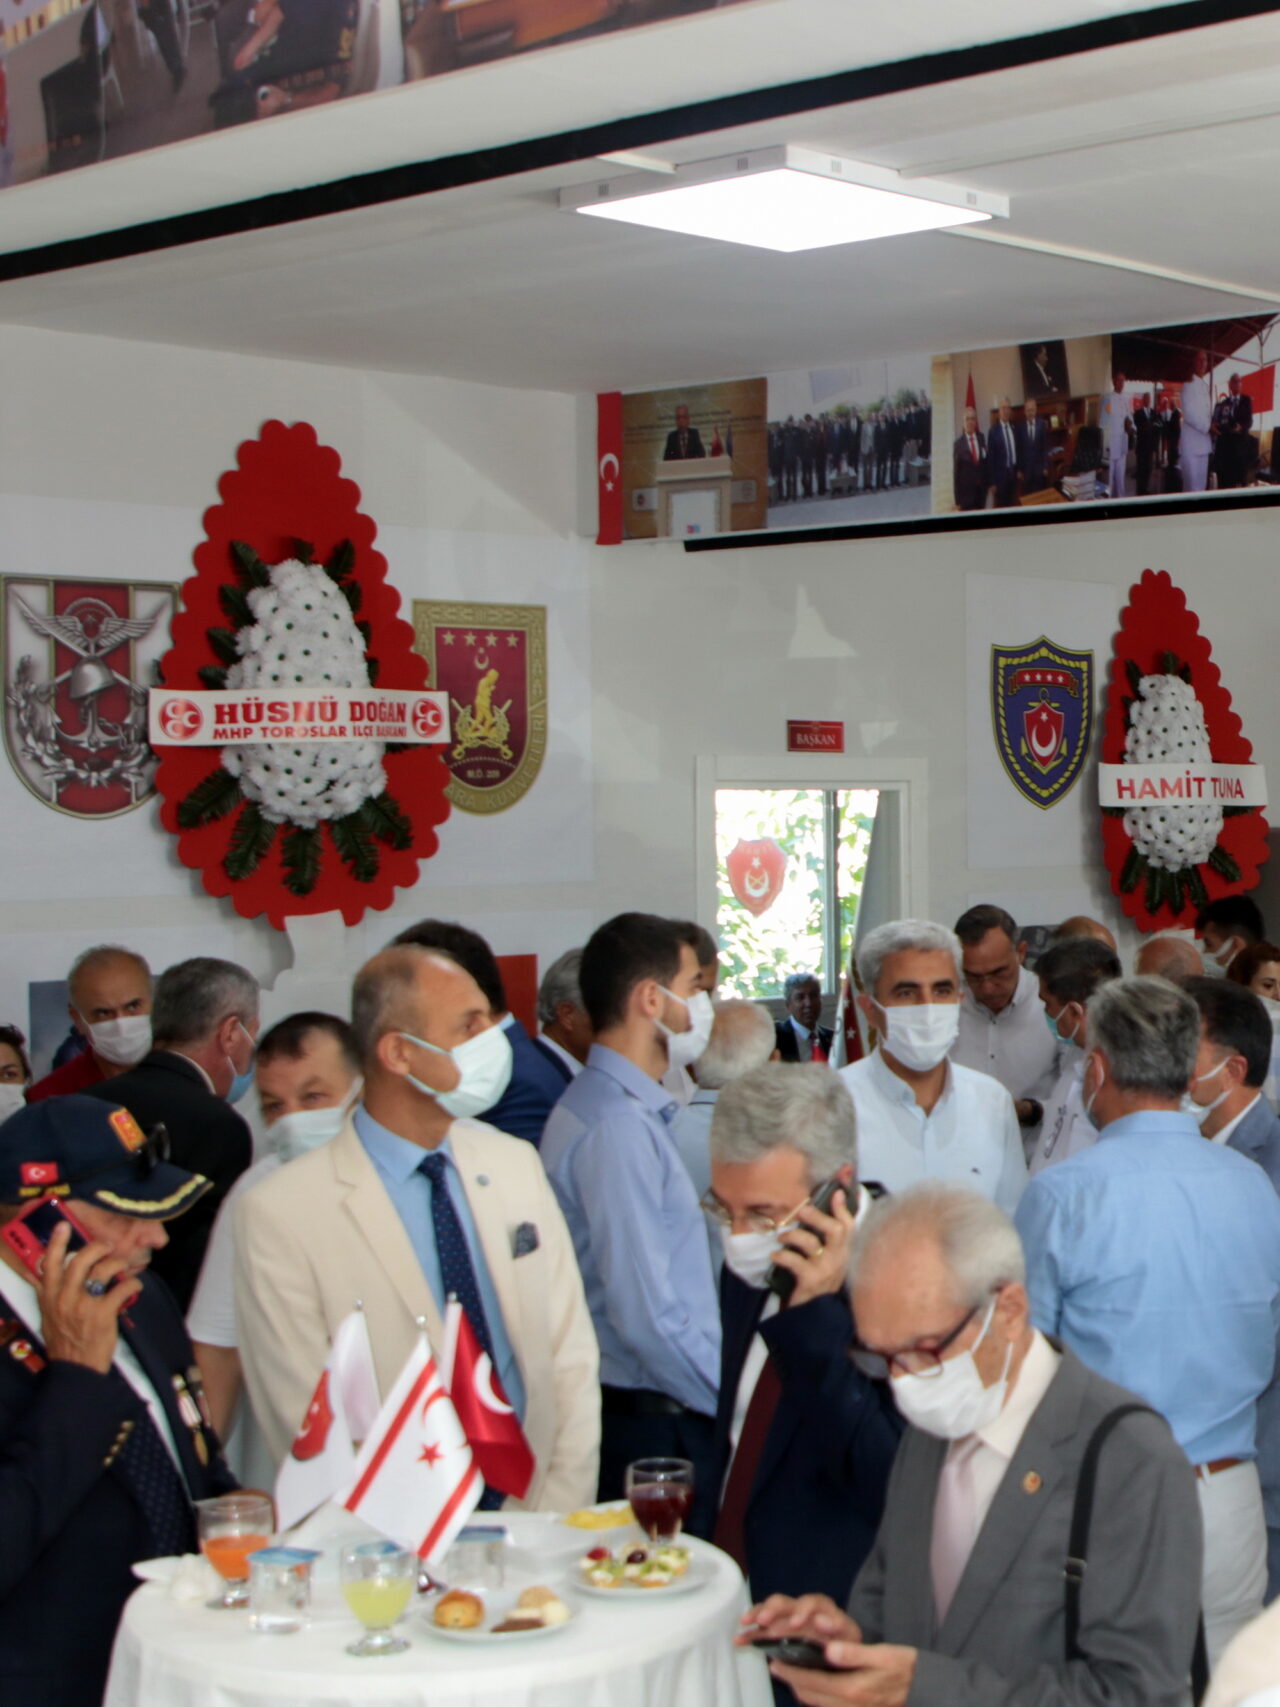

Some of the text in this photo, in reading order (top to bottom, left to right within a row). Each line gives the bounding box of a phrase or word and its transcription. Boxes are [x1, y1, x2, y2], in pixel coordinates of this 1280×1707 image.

[214, 696, 407, 725] HÜSNÜ DOĞAN
[213, 727, 253, 740] MHP
[260, 725, 347, 738] TOROSLAR
[1116, 770, 1245, 799] HAMİT TUNA
